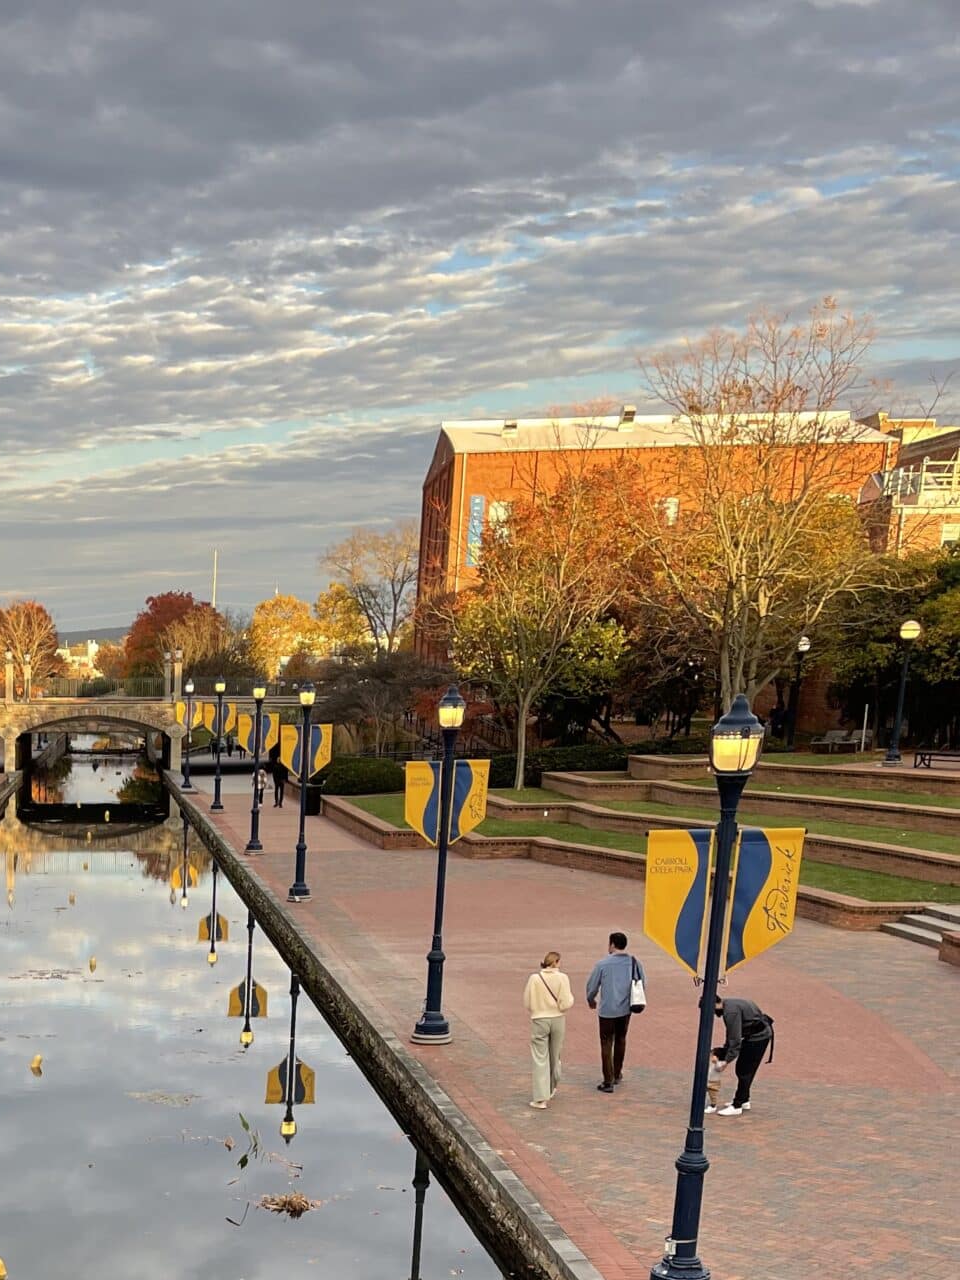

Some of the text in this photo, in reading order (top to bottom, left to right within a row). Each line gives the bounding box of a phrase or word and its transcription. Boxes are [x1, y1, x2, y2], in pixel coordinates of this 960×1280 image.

[654, 857, 688, 865] CARROLL
[649, 865, 693, 873] CREEK PARK
[762, 842, 797, 934] Frederick
